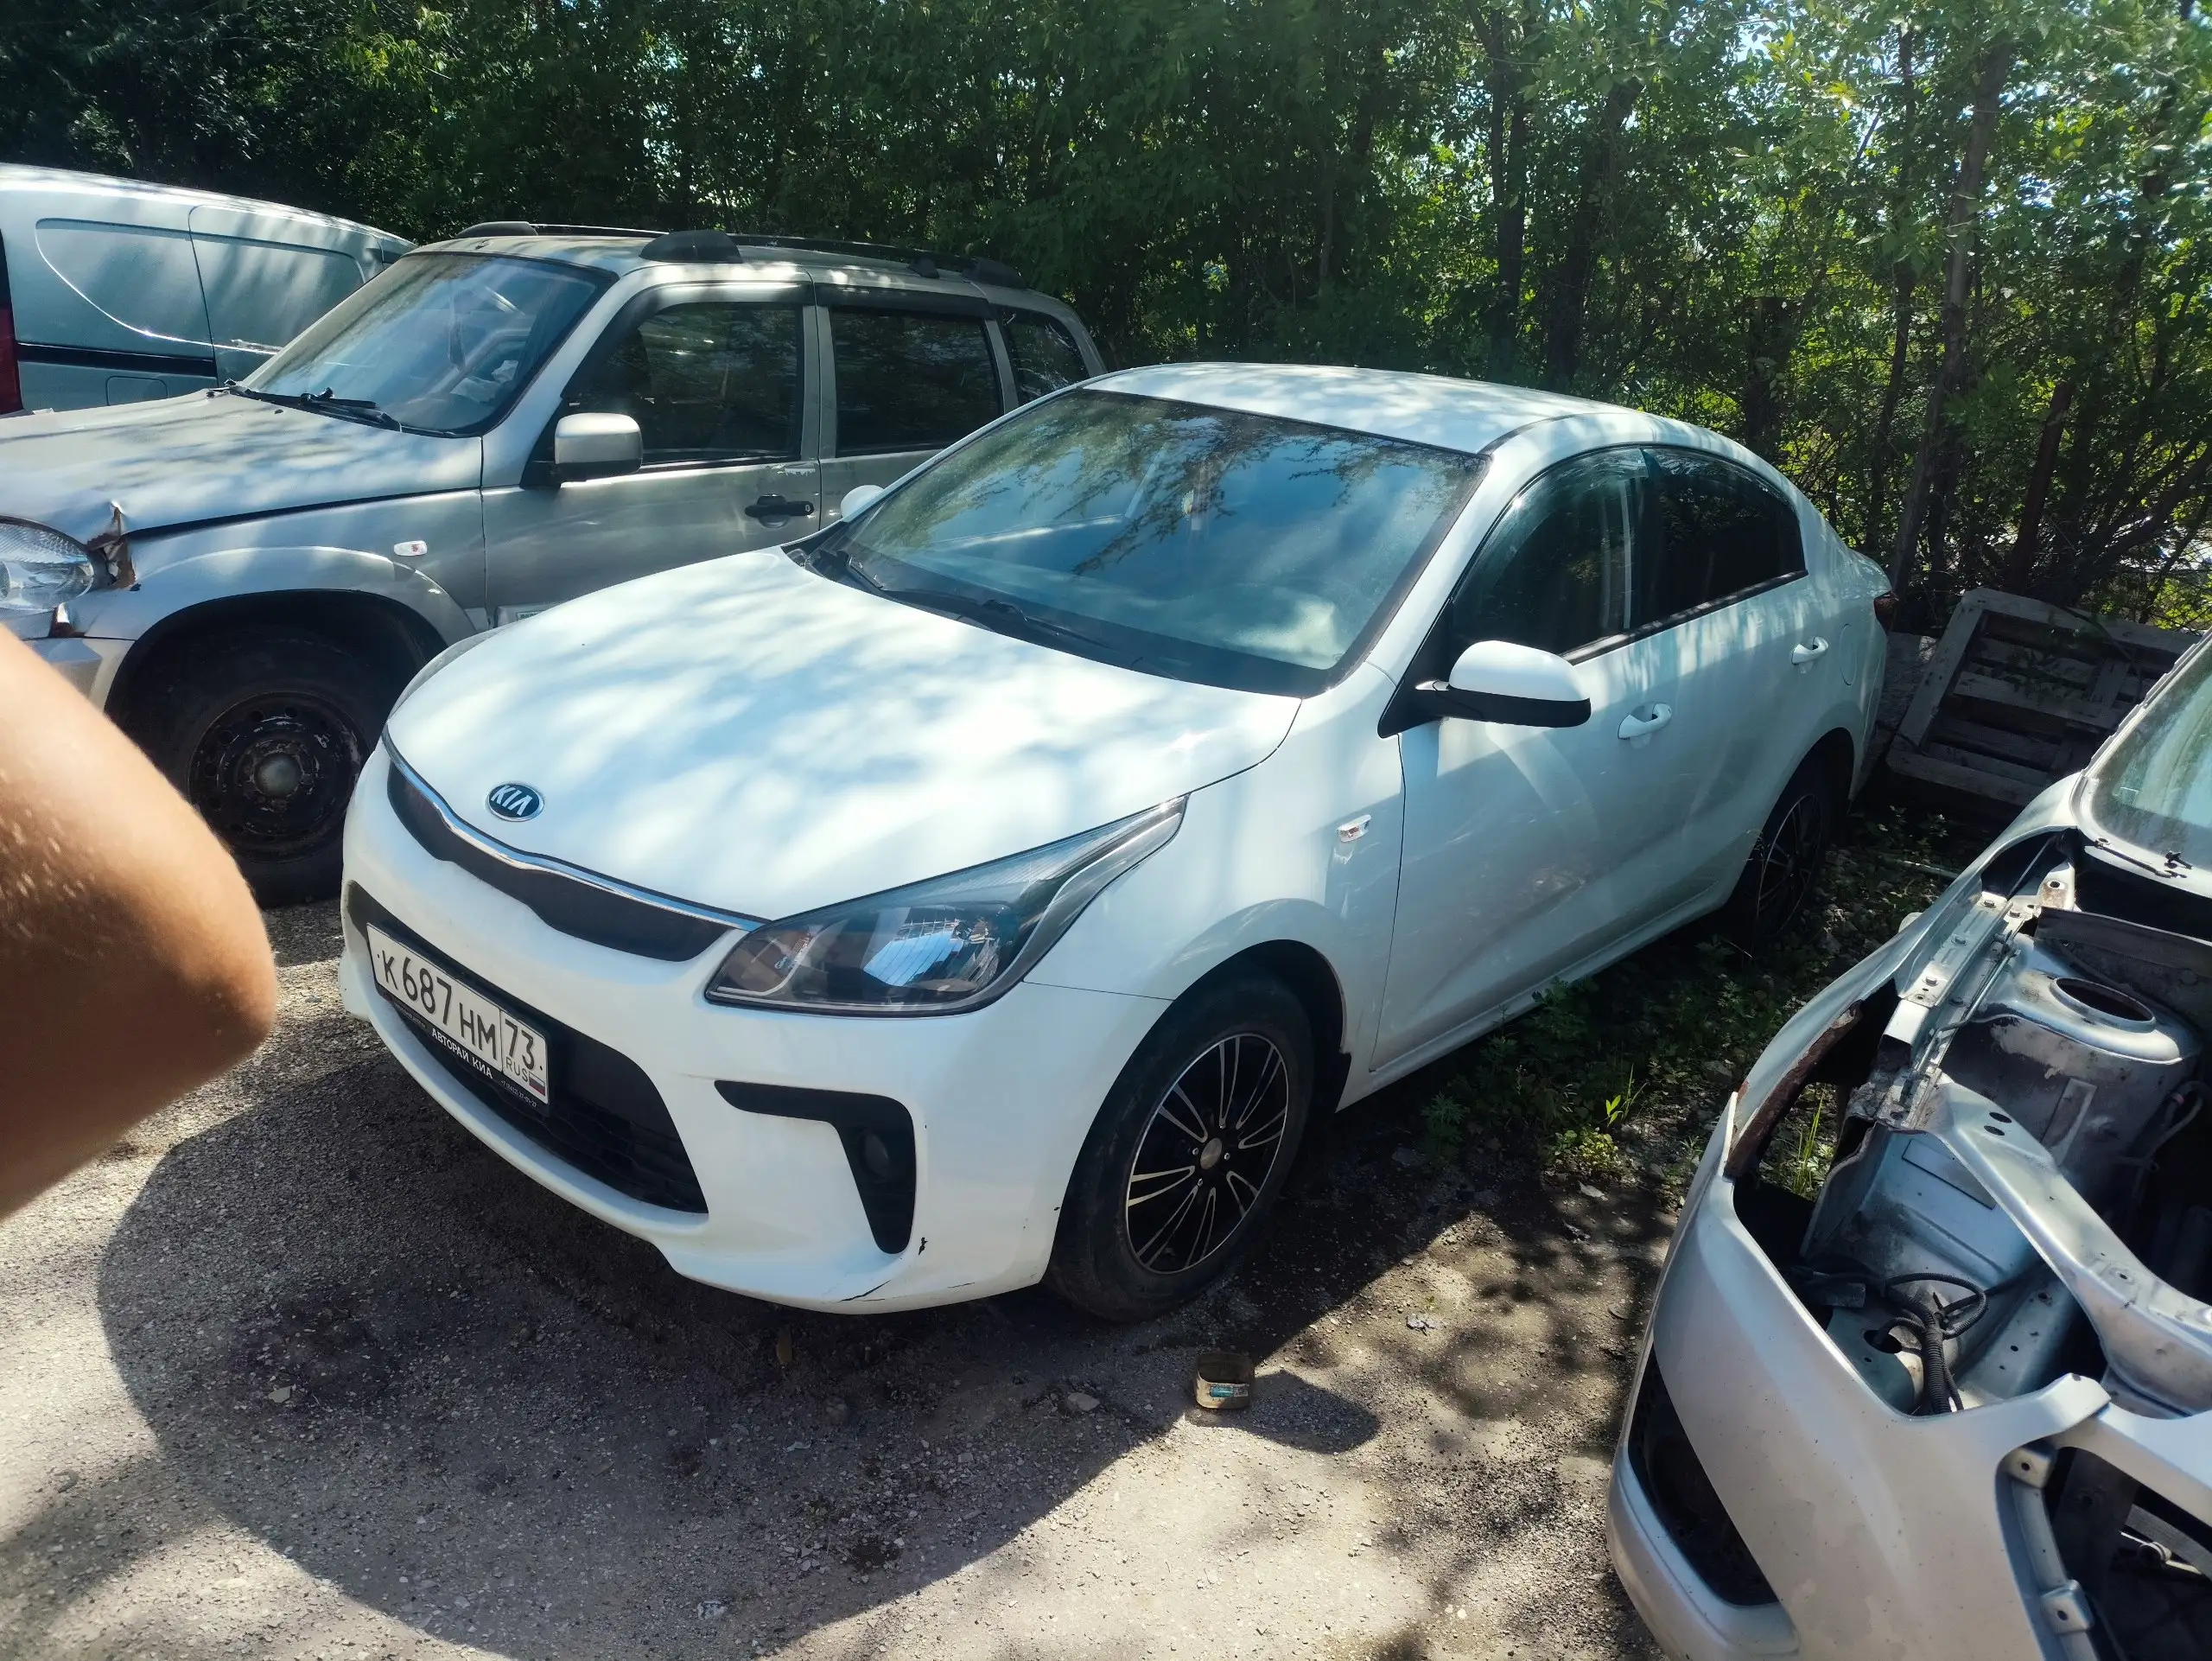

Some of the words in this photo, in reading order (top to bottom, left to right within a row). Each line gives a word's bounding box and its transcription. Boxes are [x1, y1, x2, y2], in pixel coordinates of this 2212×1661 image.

[491, 785, 532, 816] KIA
[431, 1028, 469, 1064] АВТОРАЙ
[472, 1056, 493, 1079] КИА
[505, 1055, 528, 1082] RUS
